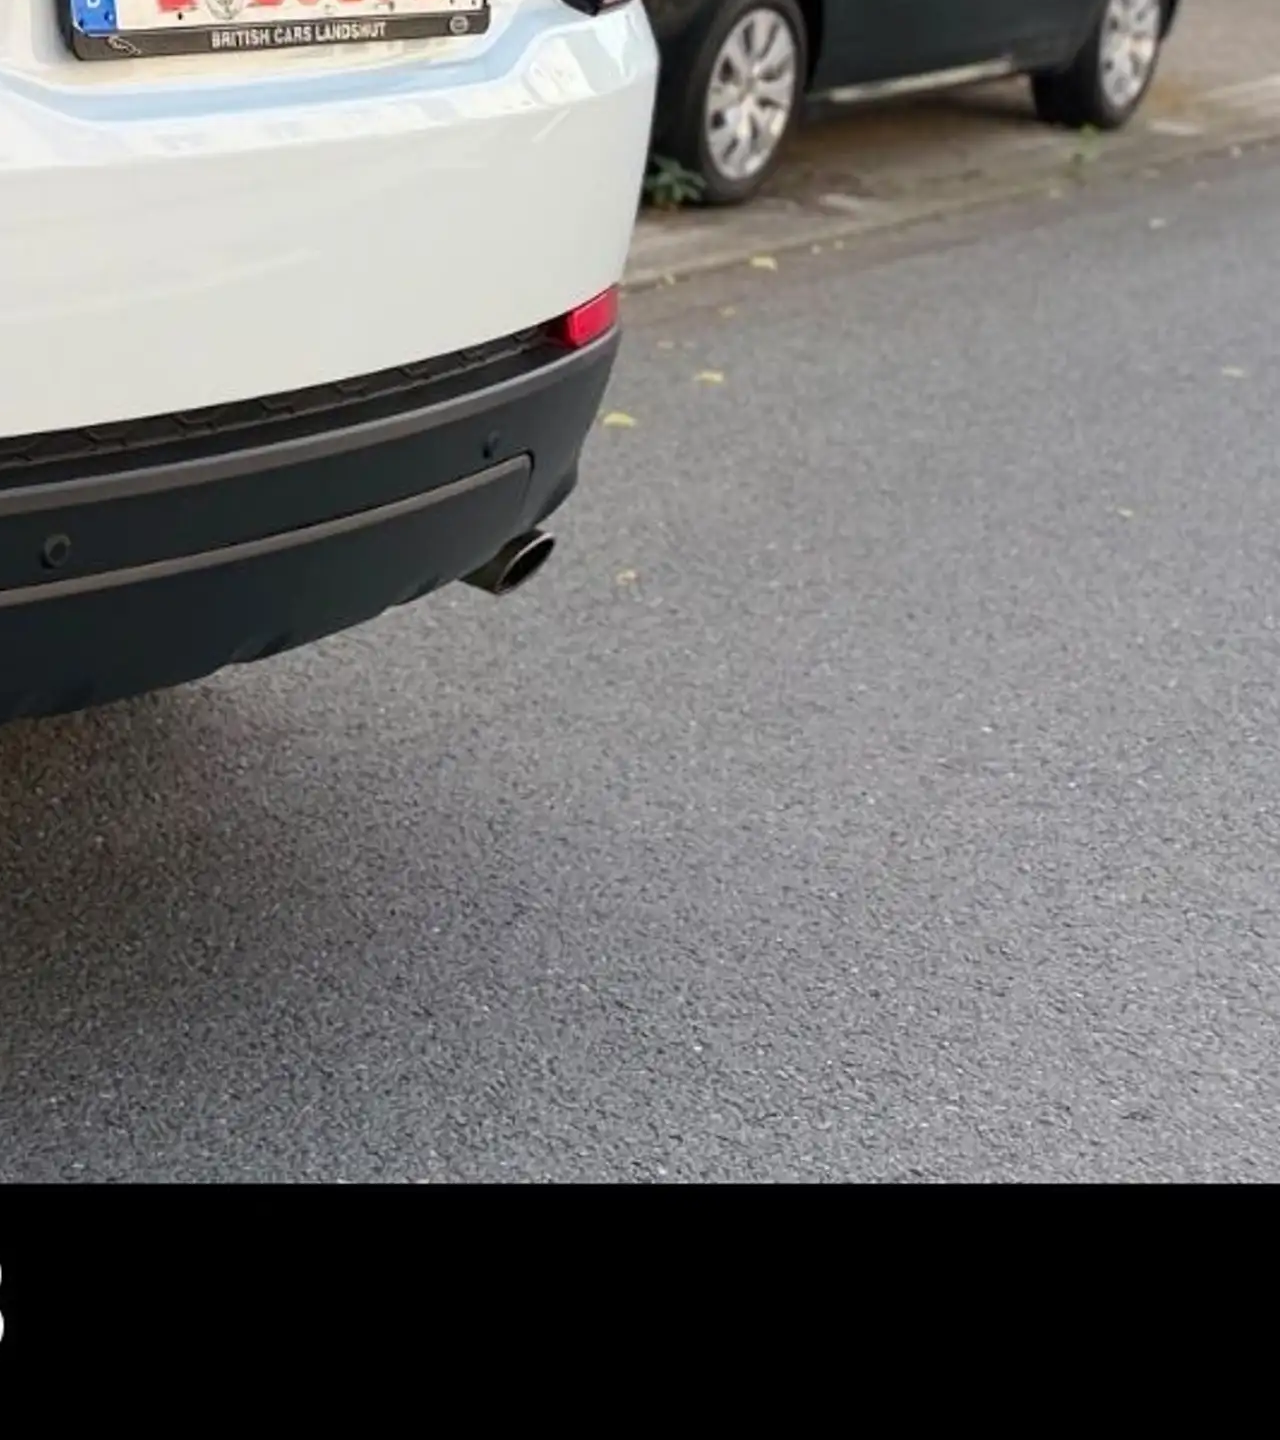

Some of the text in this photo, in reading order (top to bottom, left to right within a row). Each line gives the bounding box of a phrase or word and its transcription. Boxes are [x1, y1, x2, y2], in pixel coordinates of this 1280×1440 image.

[211, 22, 387, 49] BRITISH CARS LANDSHUT
